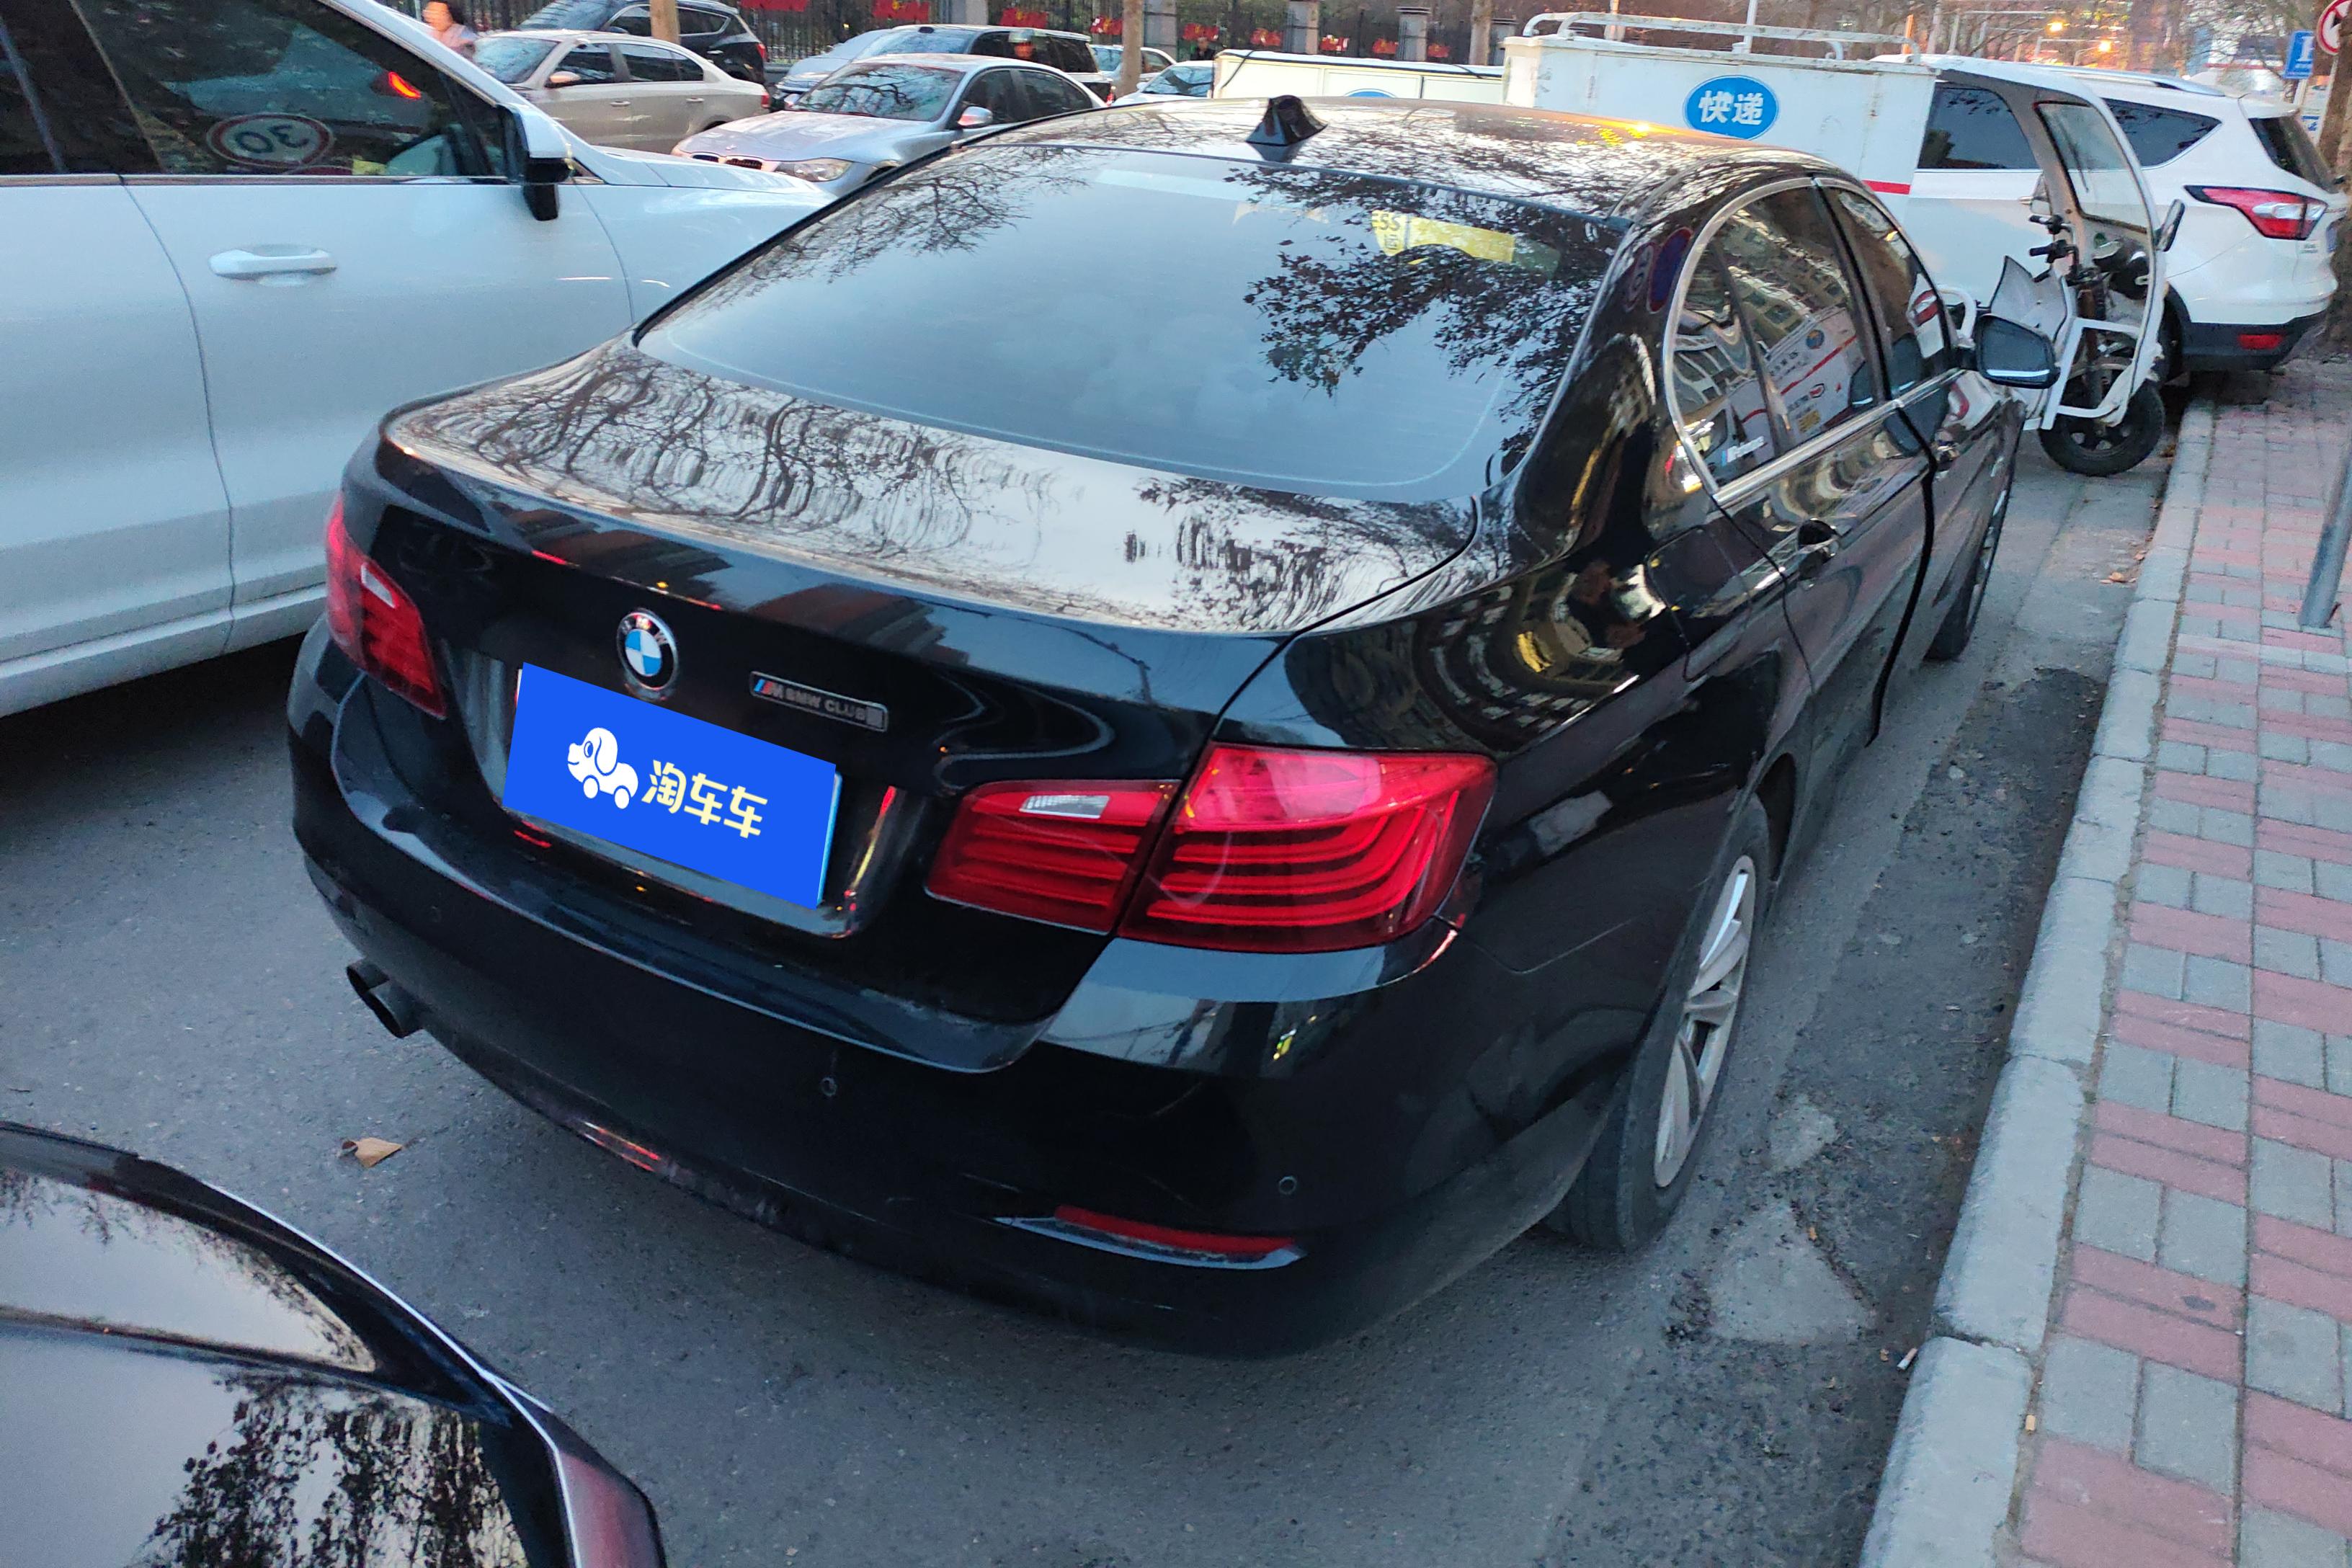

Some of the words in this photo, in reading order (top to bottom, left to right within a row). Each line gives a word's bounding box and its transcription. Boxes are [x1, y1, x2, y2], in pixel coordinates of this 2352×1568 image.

[1698, 90, 1764, 125] 快递
[785, 688, 821, 708] BMW
[824, 699, 866, 721] CLUB
